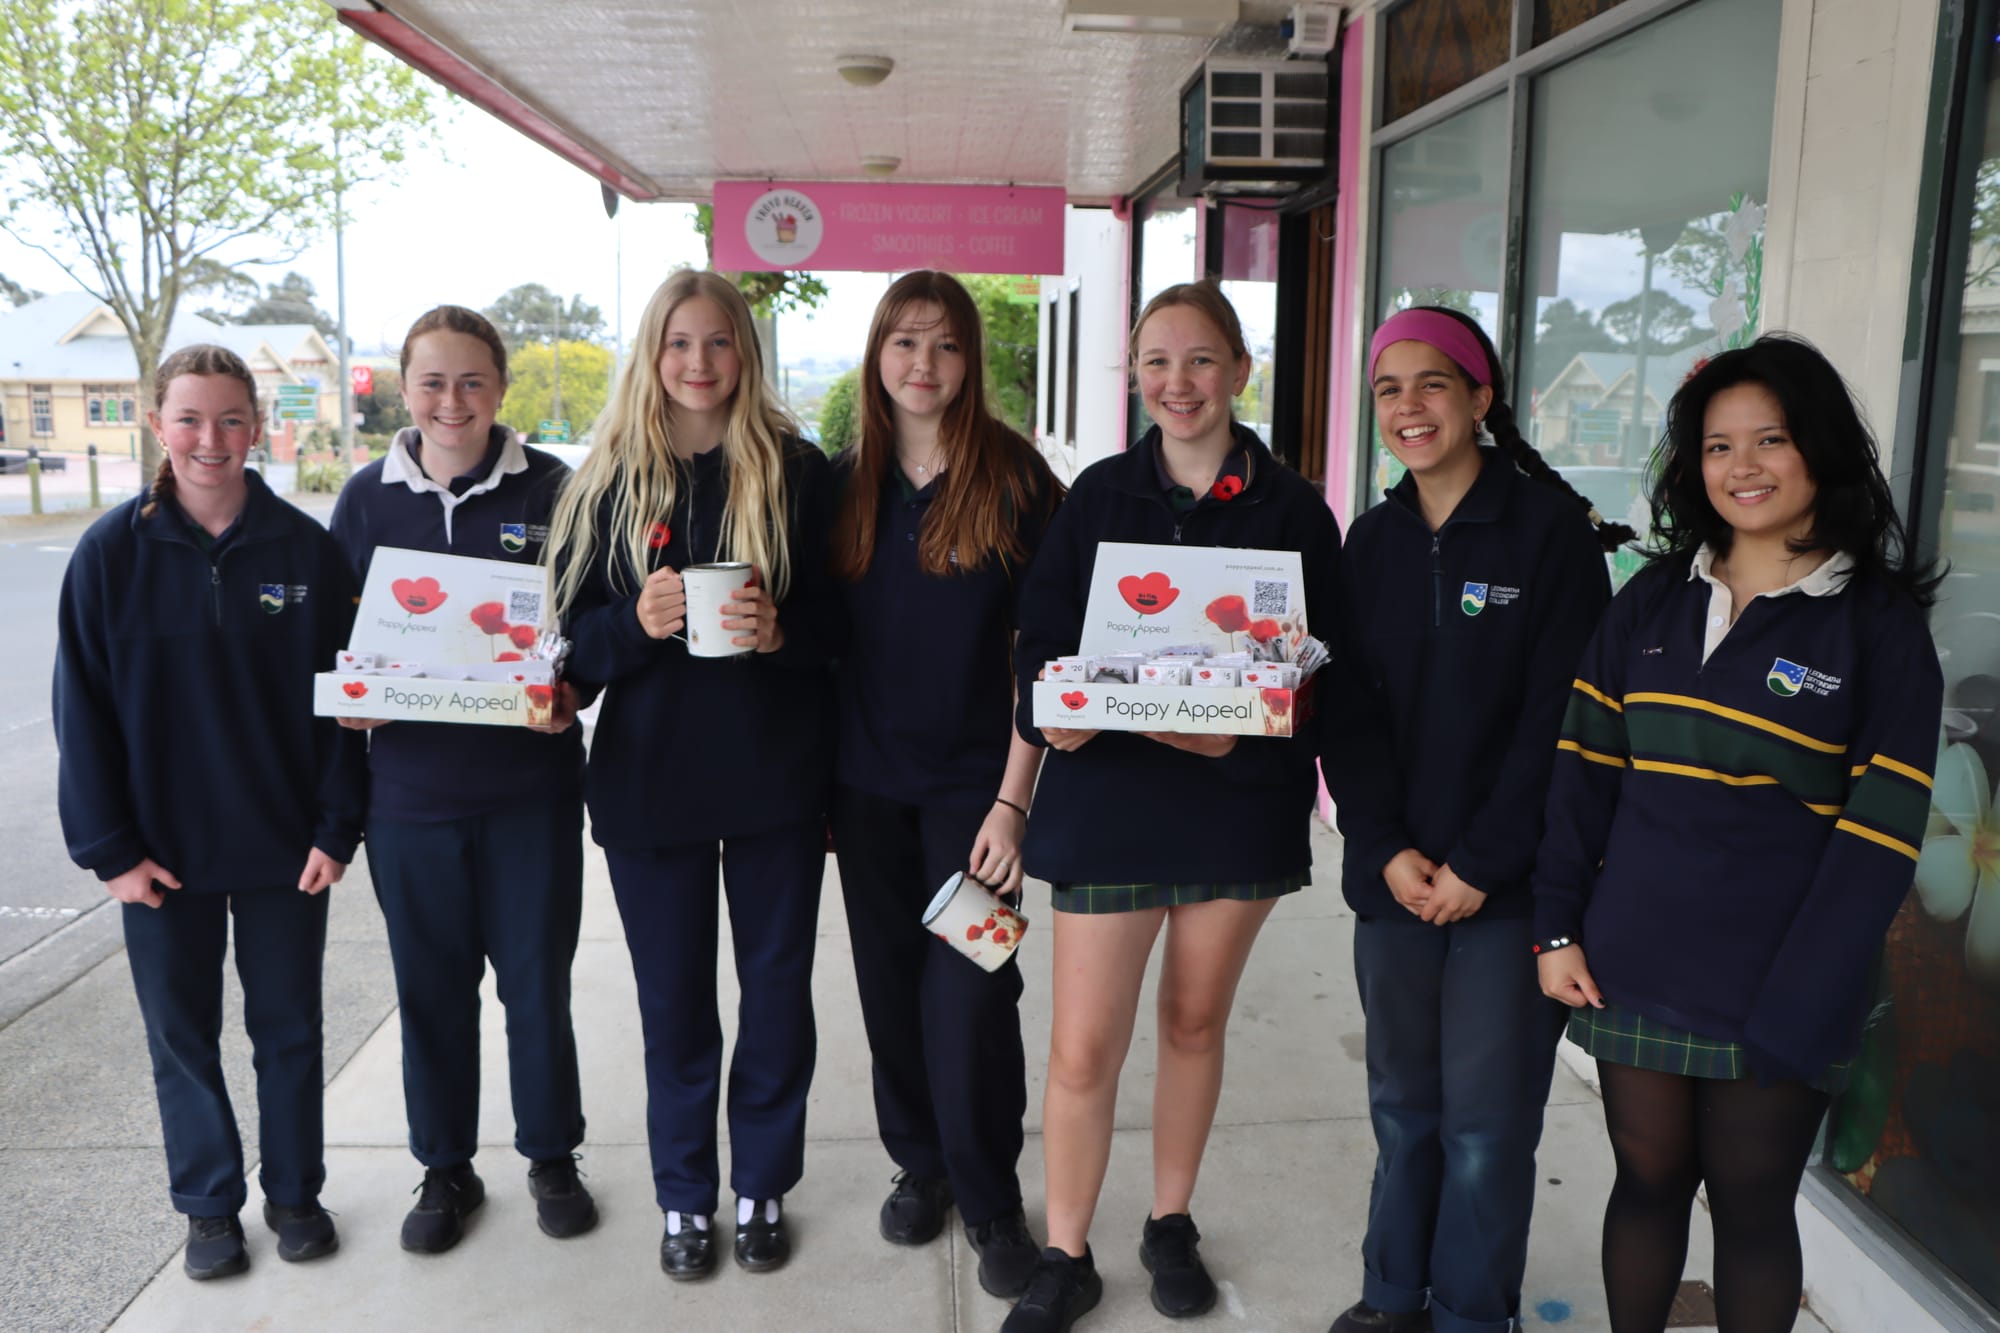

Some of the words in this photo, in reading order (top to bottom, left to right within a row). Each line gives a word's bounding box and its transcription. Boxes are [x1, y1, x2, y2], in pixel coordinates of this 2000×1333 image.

[841, 201, 893, 223] FROZEN
[897, 204, 953, 225] YOGURT
[968, 205, 989, 224] ICE
[993, 206, 1043, 226] CREAM
[871, 233, 955, 255] SMOOTHIES
[968, 235, 1016, 256] COFFEE
[1107, 621, 1134, 633] Poppy
[1136, 624, 1170, 635] Appeal
[384, 687, 443, 710] Poppy
[449, 692, 518, 712] Appeal
[1106, 696, 1170, 720] Poppy
[1176, 699, 1253, 723] Appeal
